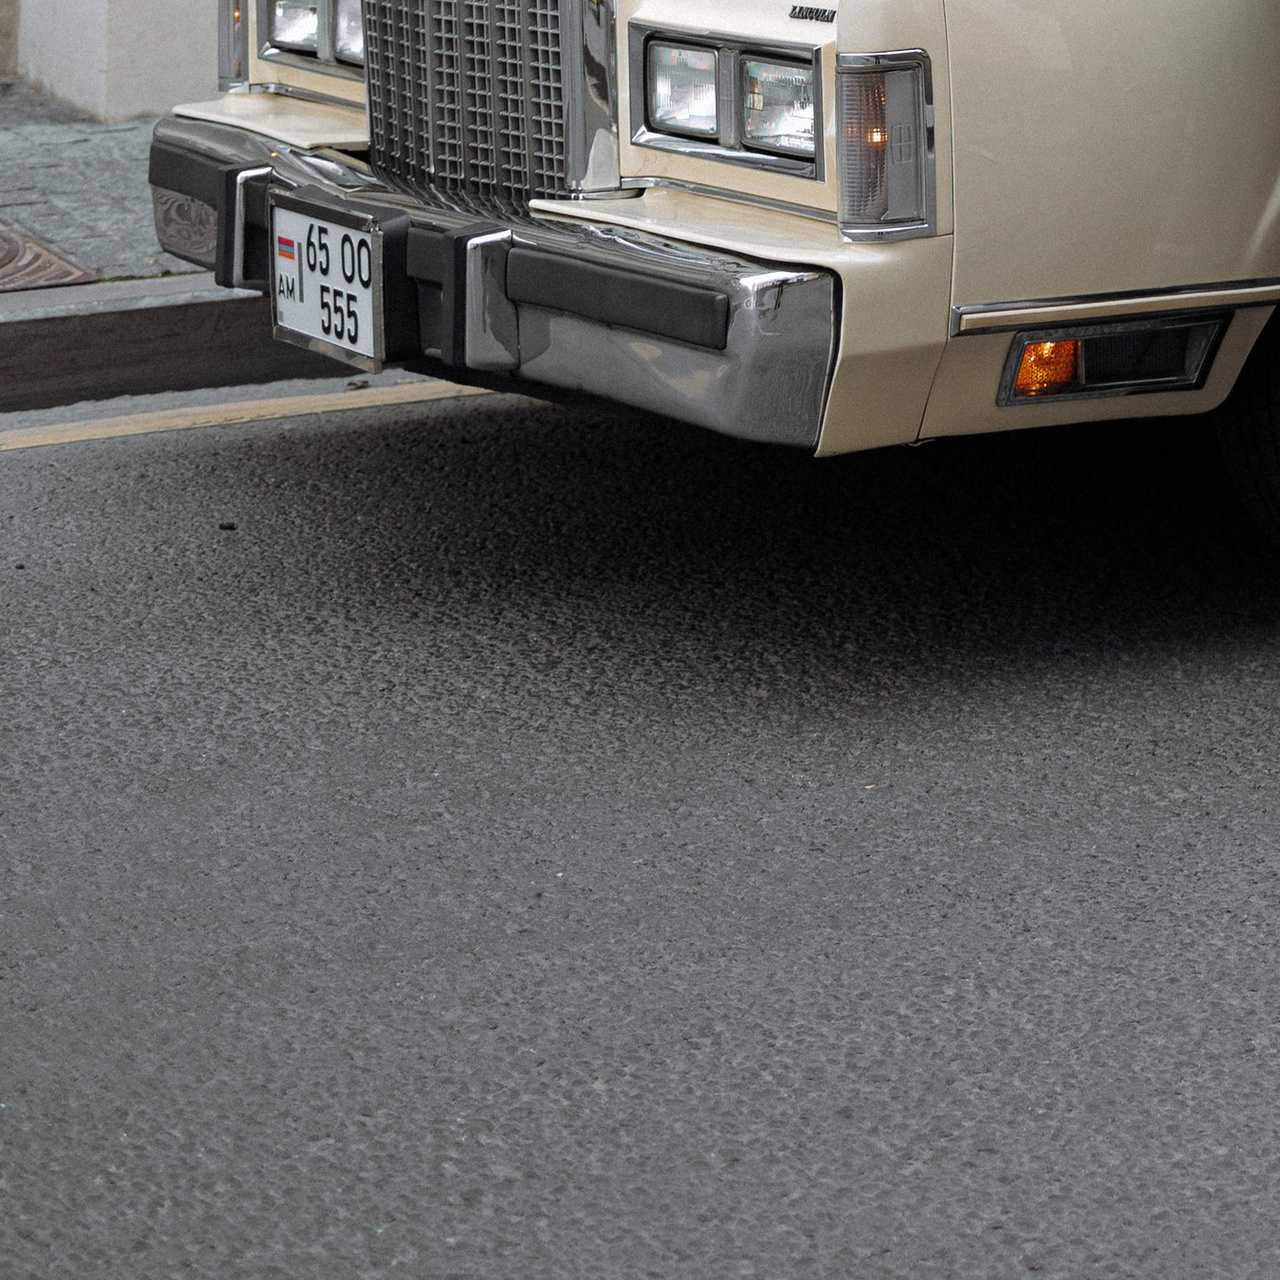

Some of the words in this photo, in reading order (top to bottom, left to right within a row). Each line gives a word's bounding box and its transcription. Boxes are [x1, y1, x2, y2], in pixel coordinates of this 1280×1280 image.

[788, 5, 837, 23] LINCOLN
[306, 223, 330, 276] 65
[341, 233, 372, 289] 00
[278, 273, 296, 302] AM
[320, 283, 359, 345] 555
